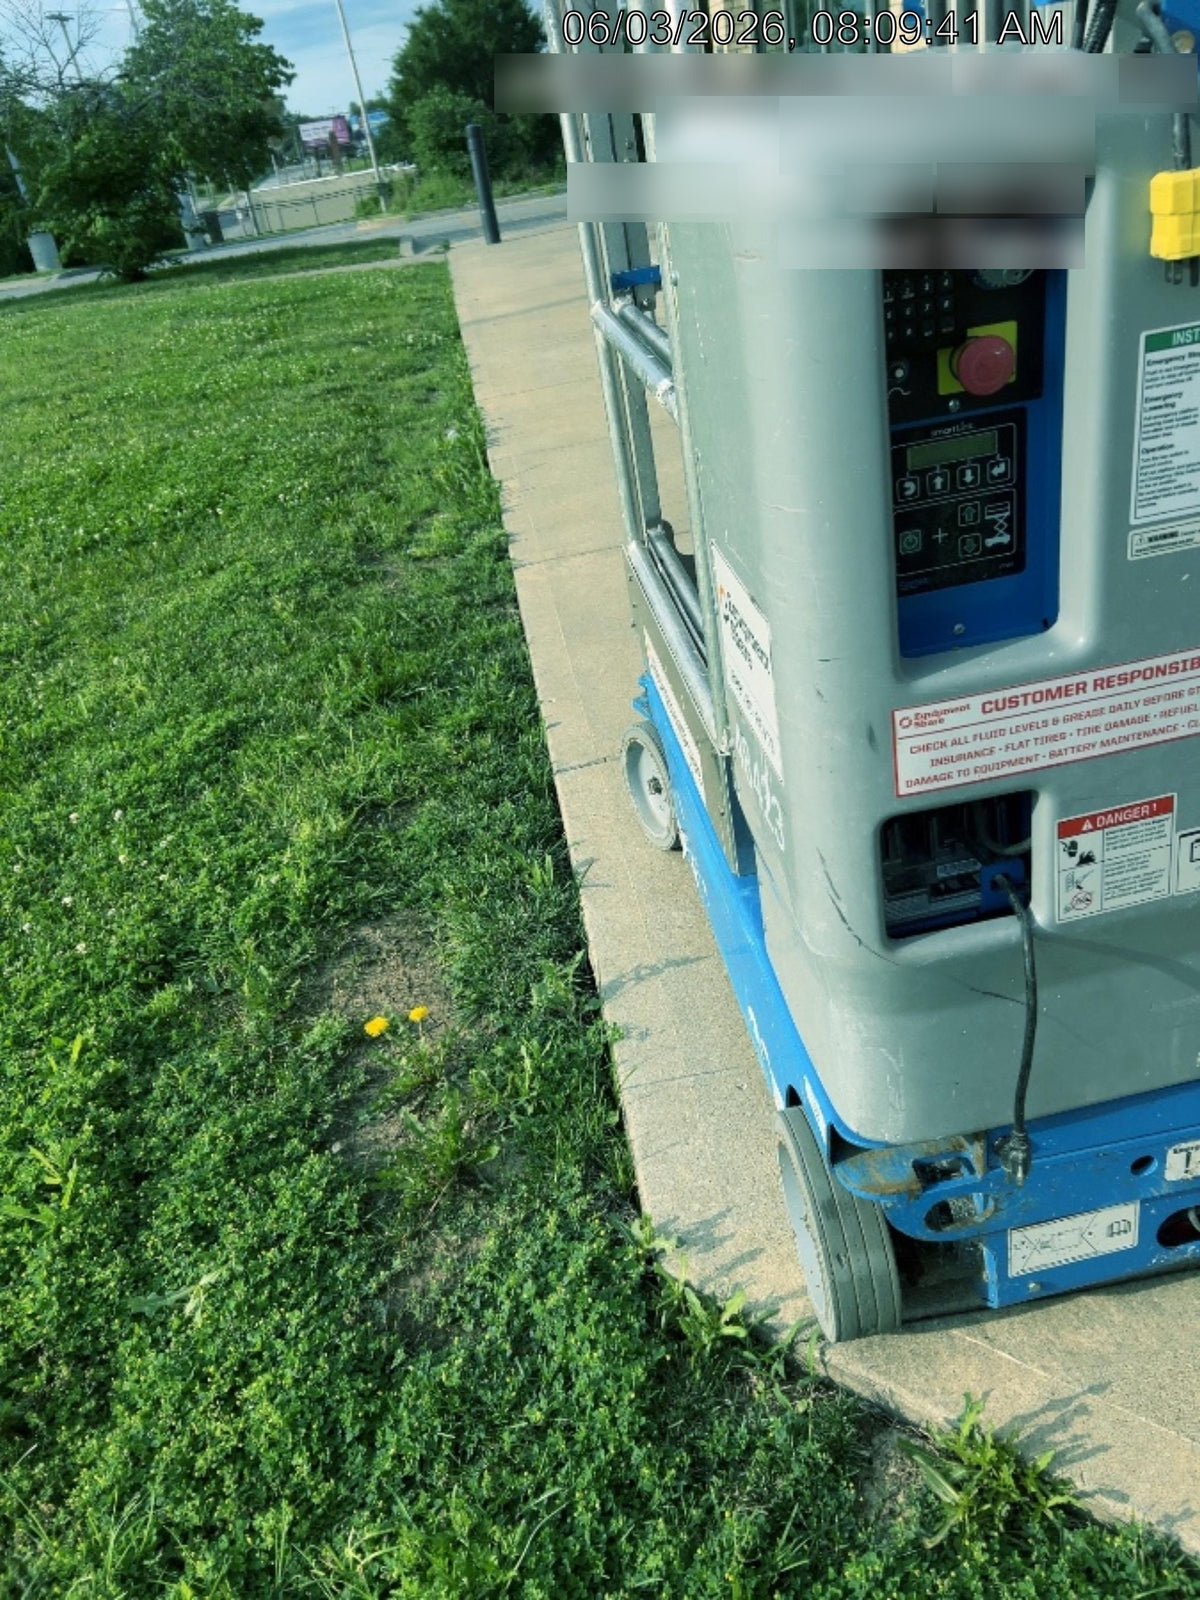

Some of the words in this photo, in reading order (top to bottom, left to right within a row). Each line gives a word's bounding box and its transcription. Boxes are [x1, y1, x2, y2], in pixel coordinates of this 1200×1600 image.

[909, 740, 948, 755] CHECK
[950, 736, 970, 748] ALL
[972, 728, 1006, 742] FLUID
[1009, 719, 1049, 735] LEVELS
[1063, 706, 1106, 724] GREASE
[1109, 699, 1141, 714] DAILY
[1143, 689, 1185, 707] BEFORE
[981, 681, 1088, 715] CUSTOMER
[906, 771, 954, 788] DAMAGE
[957, 767, 970, 778] TO
[974, 753, 1041, 775] EQUIPMENT
[1049, 741, 1097, 760] BATTERY
[1100, 723, 1179, 748] MAINTENANCE
[930, 746, 996, 768] INSURANCE
[1004, 739, 1031, 753] FLAT
[1033, 731, 1067, 746] TIRES
[1076, 724, 1101, 737] TIRE
[1104, 713, 1151, 731] DAMAGE
[1096, 804, 1150, 828] DANGER
